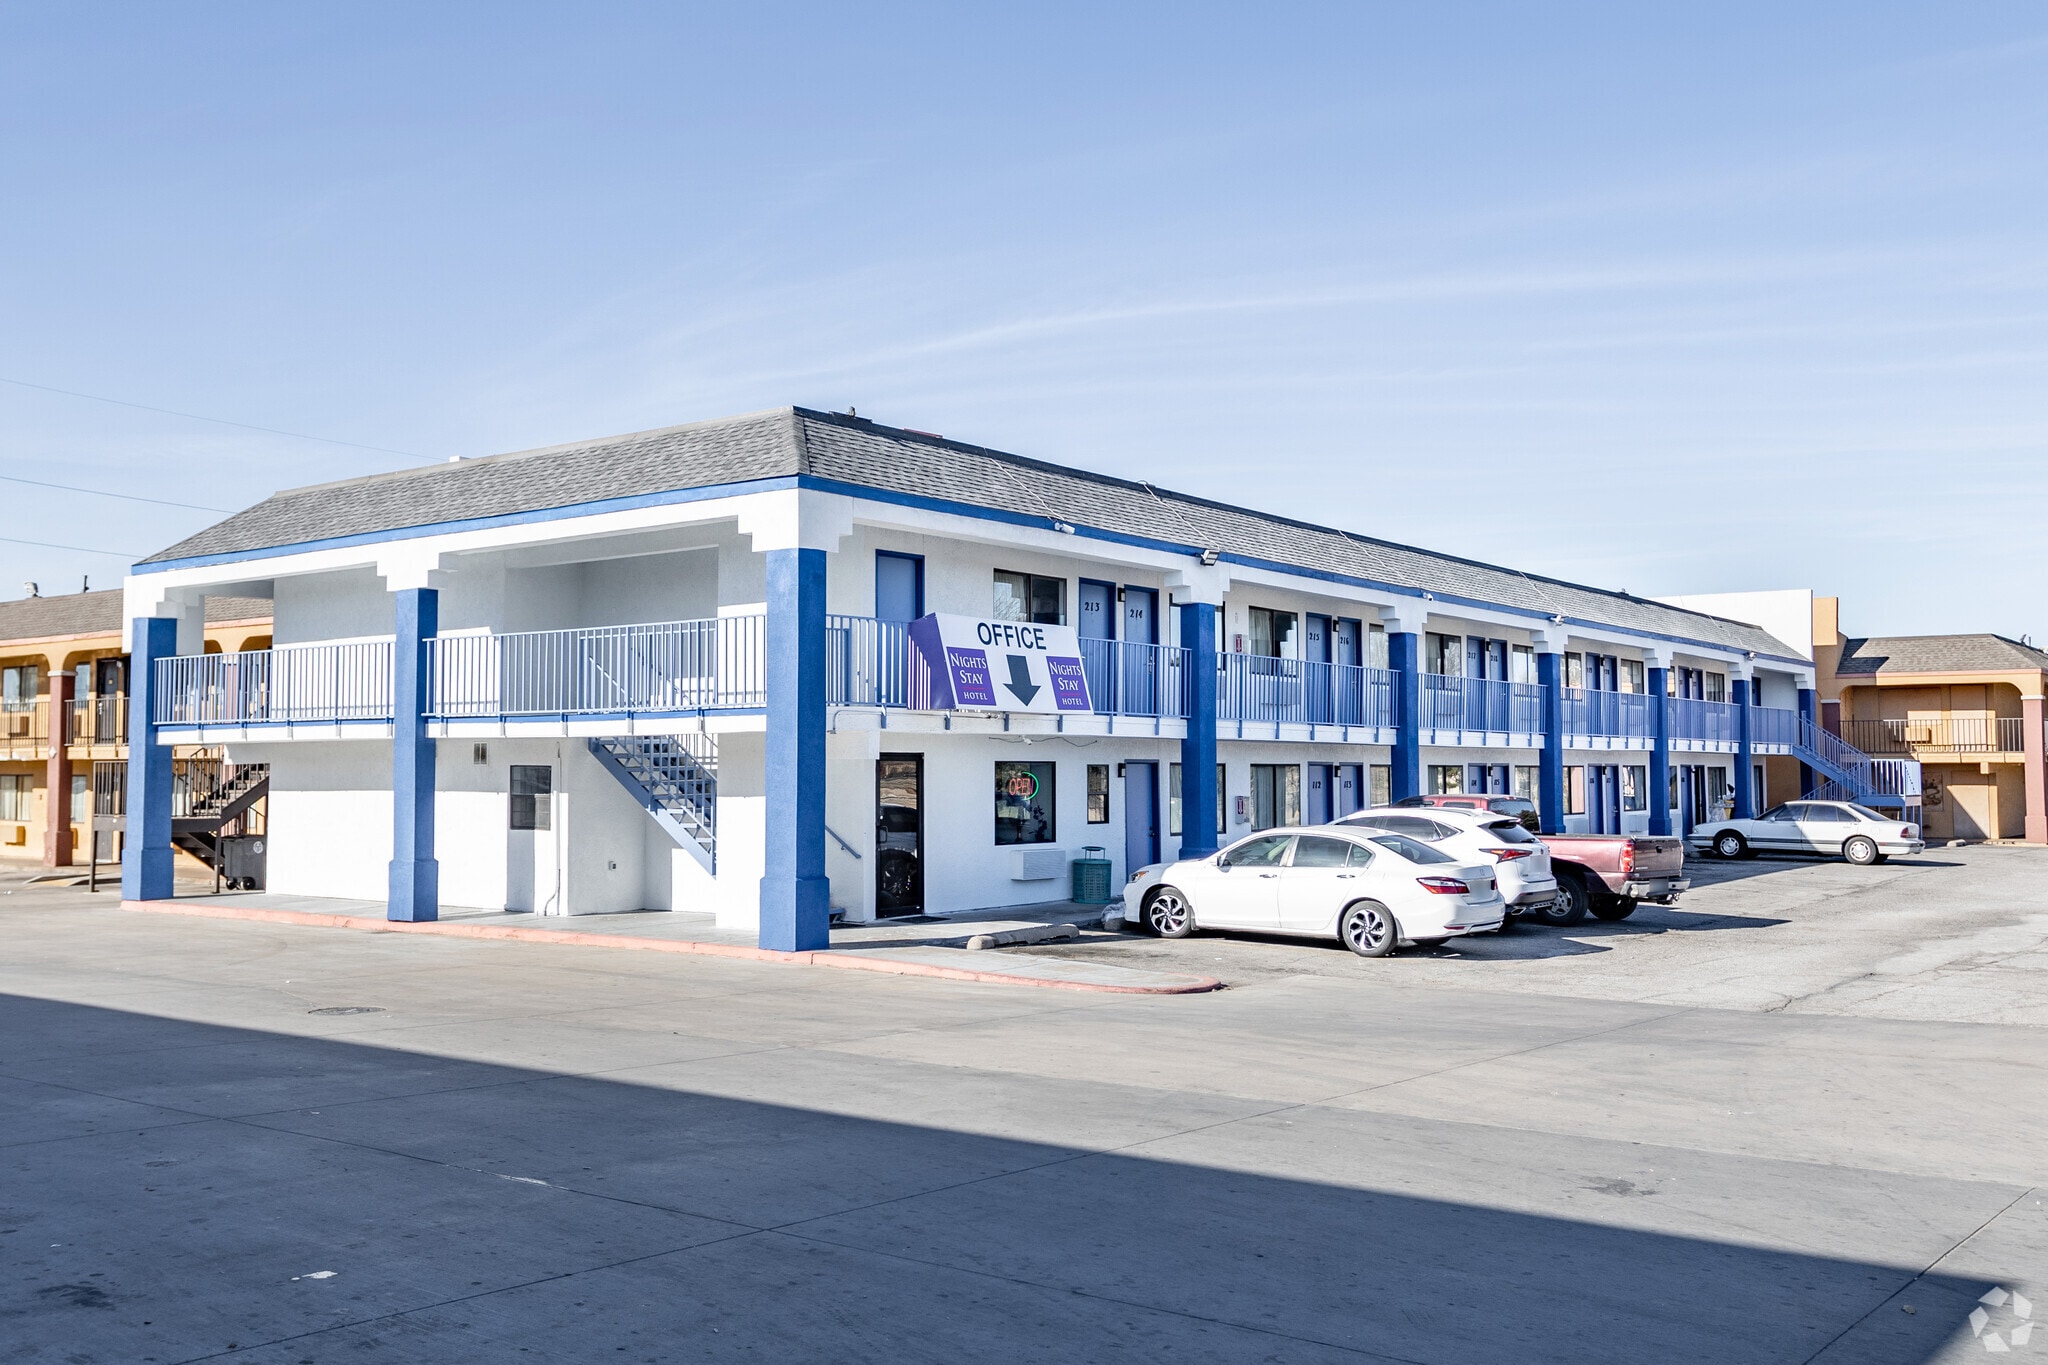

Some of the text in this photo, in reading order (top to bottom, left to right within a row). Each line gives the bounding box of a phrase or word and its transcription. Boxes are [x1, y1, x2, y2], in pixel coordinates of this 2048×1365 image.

[1085, 602, 1100, 612] 213
[1130, 609, 1143, 619] 214
[977, 622, 1046, 650] OFFICE
[1309, 632, 1320, 641] 215
[1340, 637, 1350, 646] 216
[963, 691, 988, 701] HOTEL
[1061, 697, 1084, 706] HOTEL
[1008, 777, 1034, 796] OPEN
